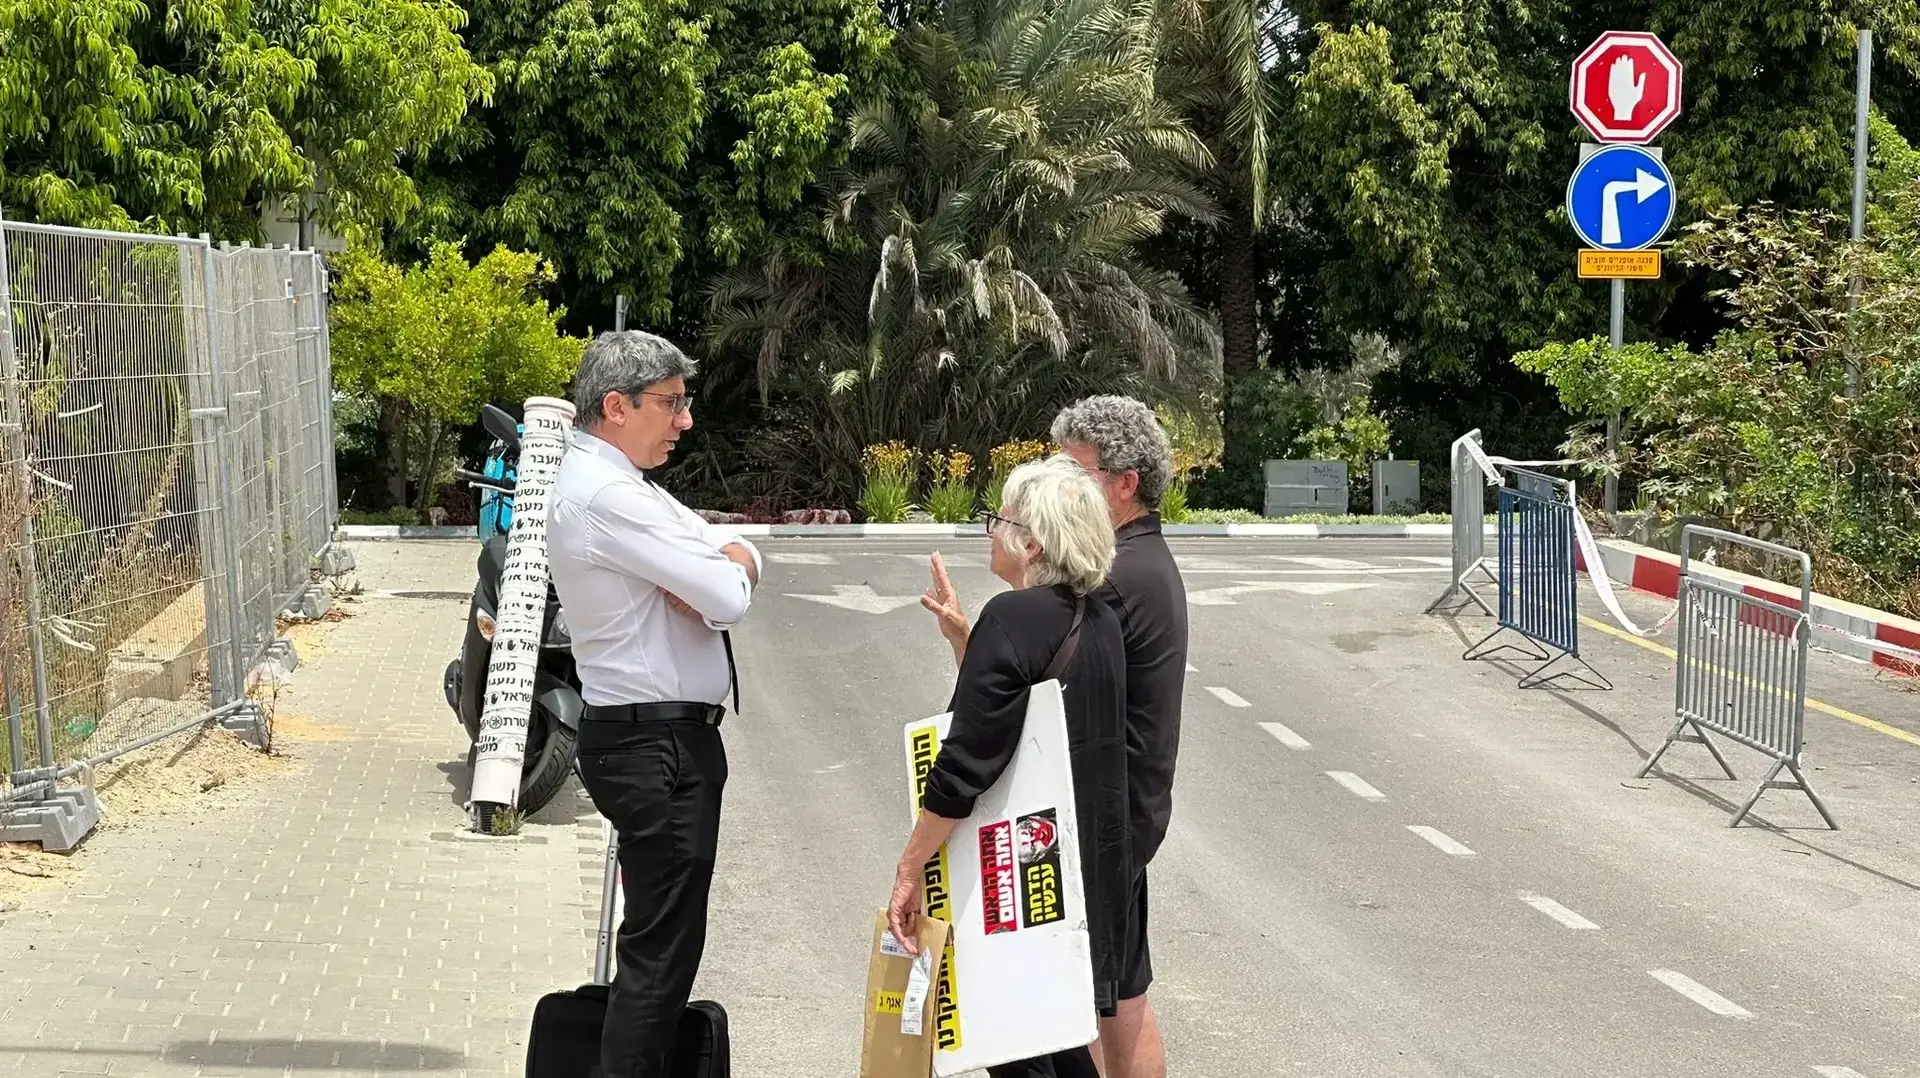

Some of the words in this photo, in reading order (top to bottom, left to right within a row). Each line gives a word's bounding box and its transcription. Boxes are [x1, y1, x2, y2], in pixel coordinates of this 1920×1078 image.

[536, 418, 563, 431] עבר
[530, 454, 563, 467] מעבר
[501, 690, 532, 703] שראל
[994, 825, 1012, 867] אתה
[997, 868, 1015, 923] אשם
[1027, 866, 1044, 923] הדחה
[1040, 863, 1058, 920] עכשיו
